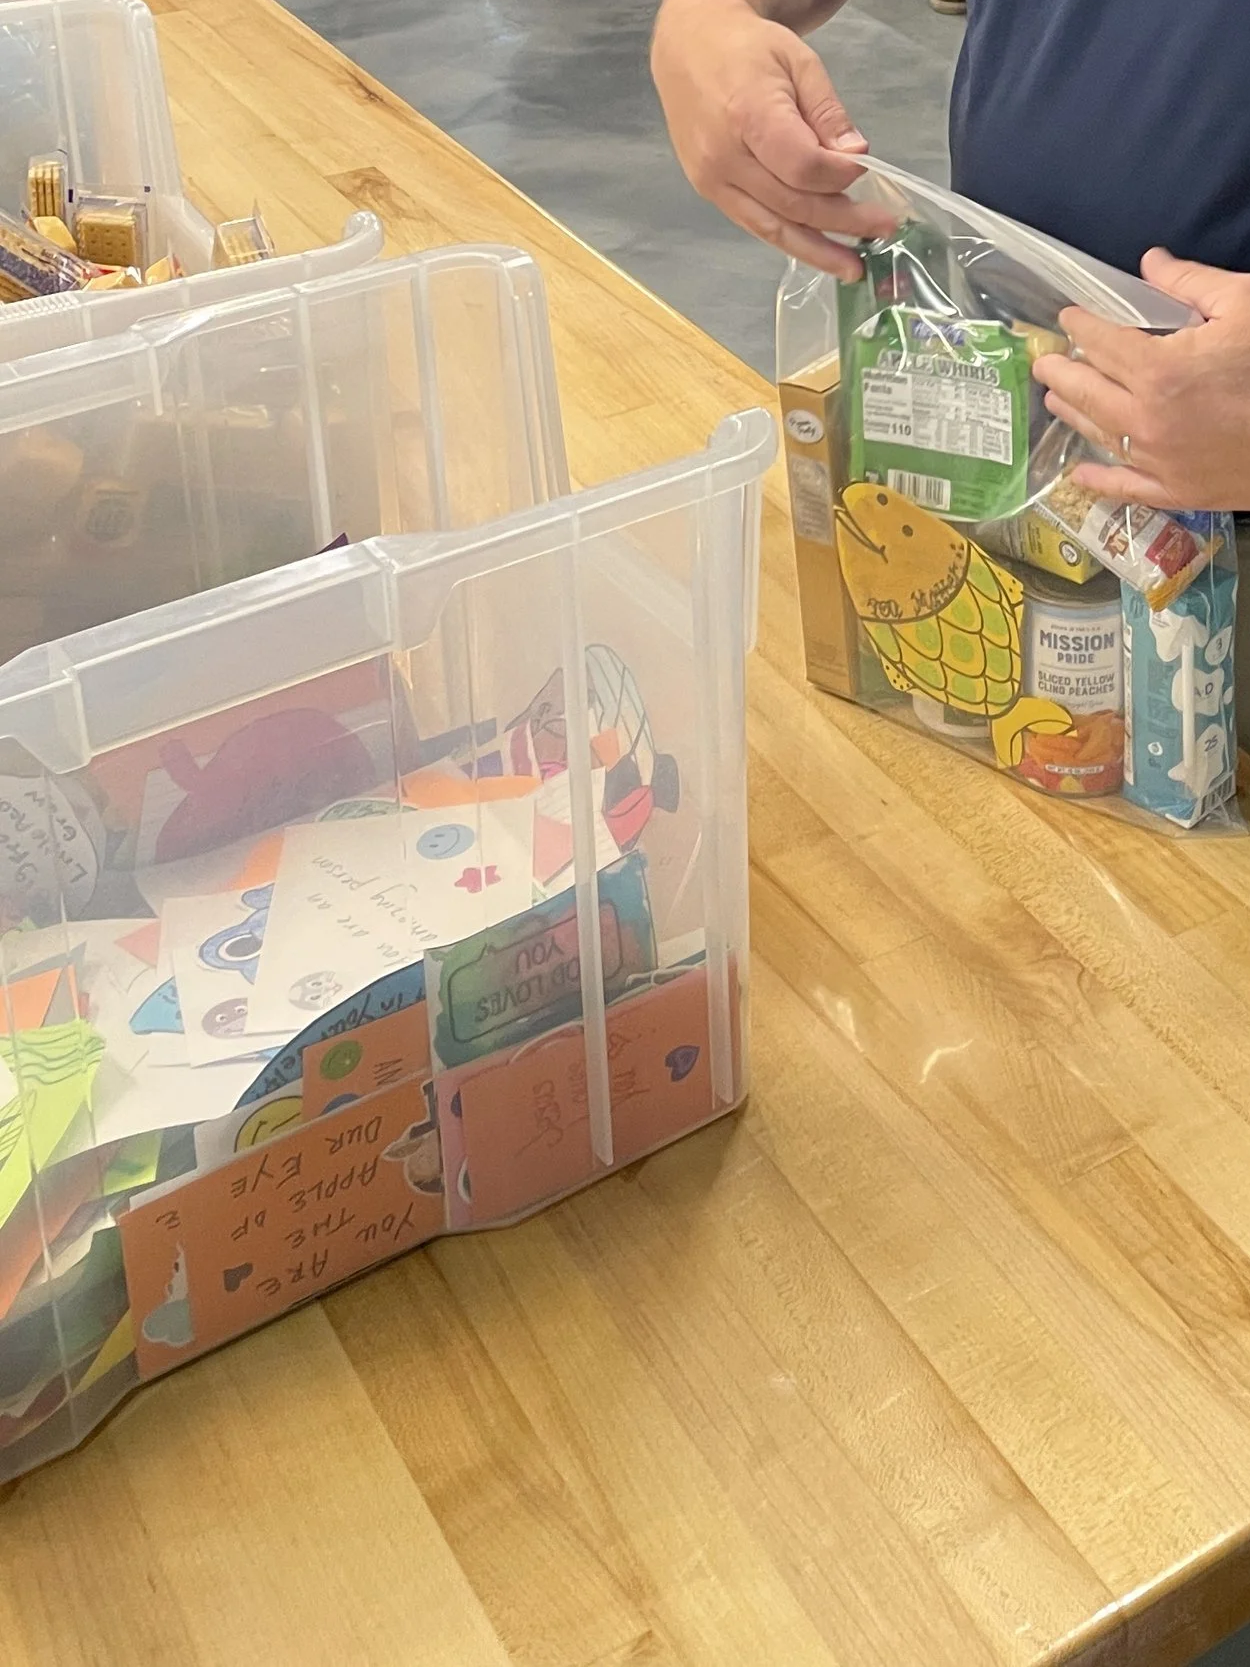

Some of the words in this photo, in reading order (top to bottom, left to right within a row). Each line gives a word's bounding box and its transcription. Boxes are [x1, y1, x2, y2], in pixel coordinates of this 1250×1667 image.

[891, 423, 912, 436] 110
[1040, 629, 1115, 652] MISSION
[1057, 651, 1096, 665] PRIDE
[1038, 670, 1071, 687] SLICED
[1075, 672, 1115, 687] YELLOW
[1068, 682, 1115, 697] PEACHES
[307, 893, 332, 910] an
[514, 936, 565, 975] YOU
[475, 977, 544, 1024] LOVES
[323, 1115, 383, 1156] OUR
[229, 1149, 303, 1200] EYE
[288, 1154, 380, 1214] APPLE
[230, 1209, 267, 1242] OF
[284, 1206, 356, 1250] THE
[255, 1248, 329, 1296] ARE
